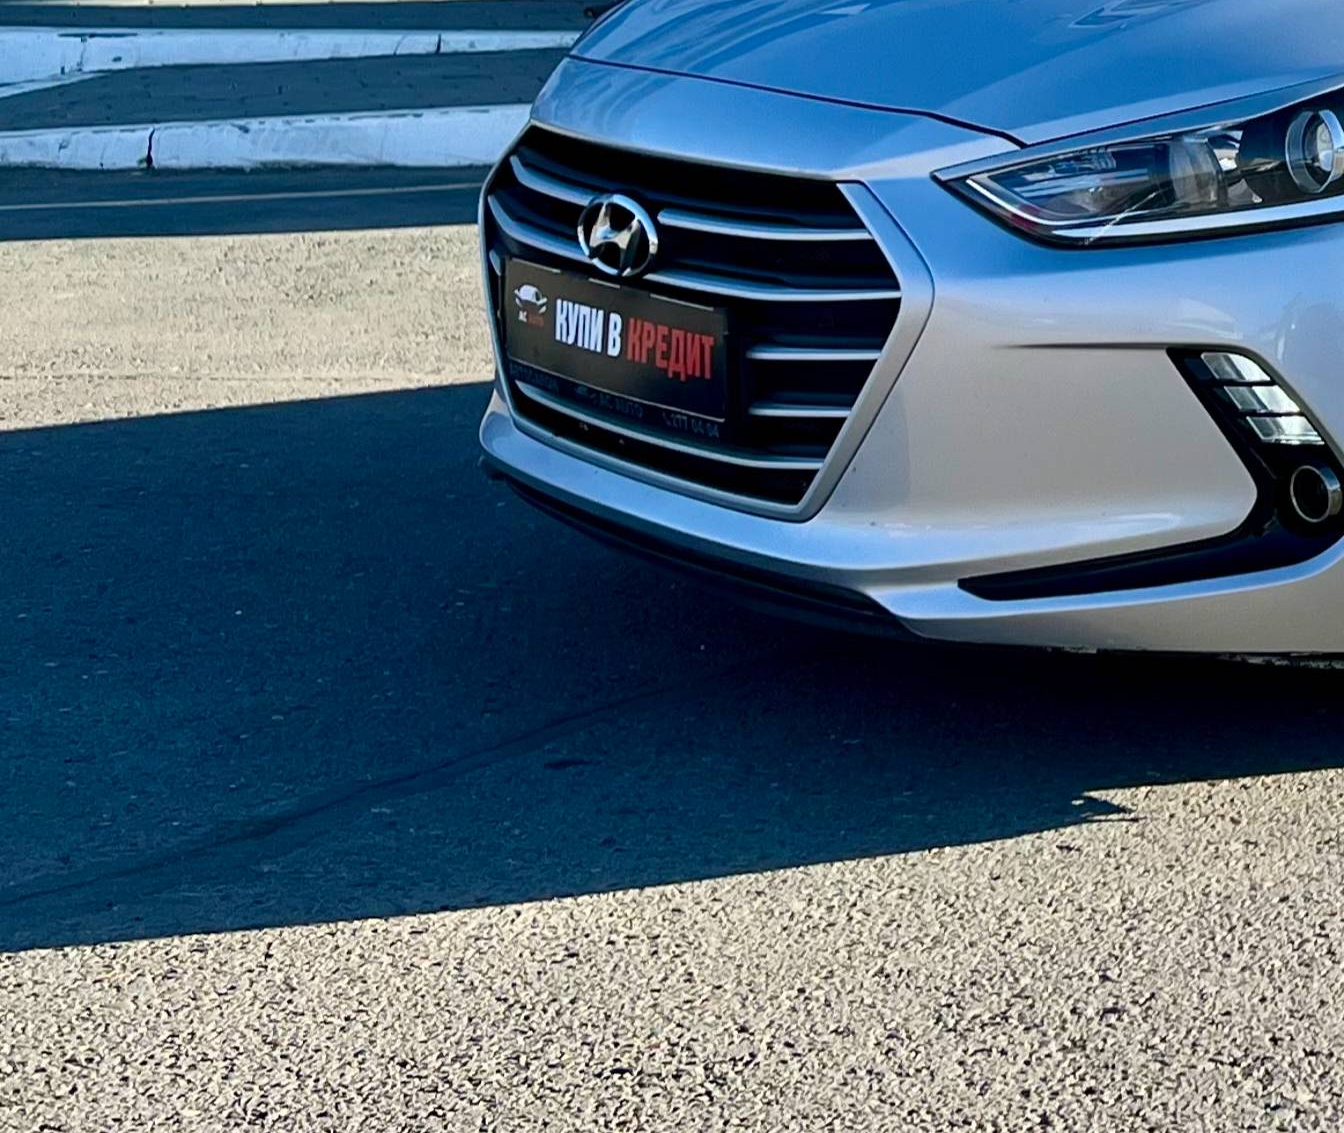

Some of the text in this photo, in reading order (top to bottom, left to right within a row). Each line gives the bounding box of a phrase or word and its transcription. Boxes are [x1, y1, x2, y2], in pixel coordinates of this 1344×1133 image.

[554, 298, 604, 354] КУПИ
[606, 312, 623, 357] В
[627, 317, 715, 382] КРЕДИТ
